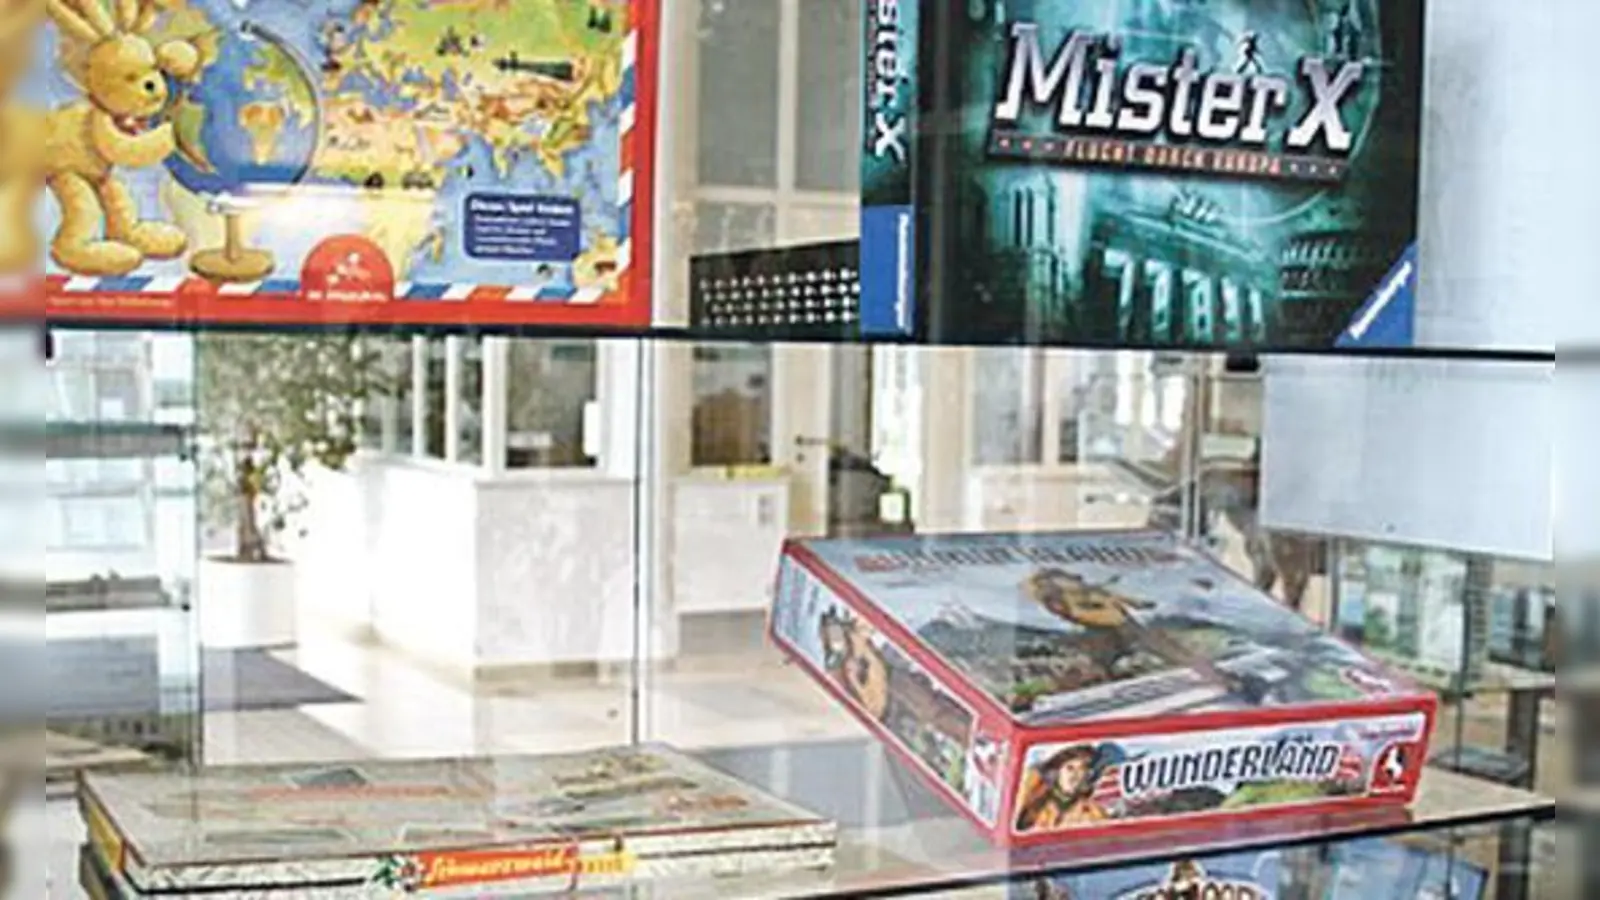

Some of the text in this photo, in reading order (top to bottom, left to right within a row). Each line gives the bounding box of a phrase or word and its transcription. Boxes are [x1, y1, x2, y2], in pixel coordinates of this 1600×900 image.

[995, 21, 1288, 143] Mister
[1287, 57, 1363, 150] X
[875, 112, 906, 161] X
[1121, 738, 1340, 795] WUNDERLAND
